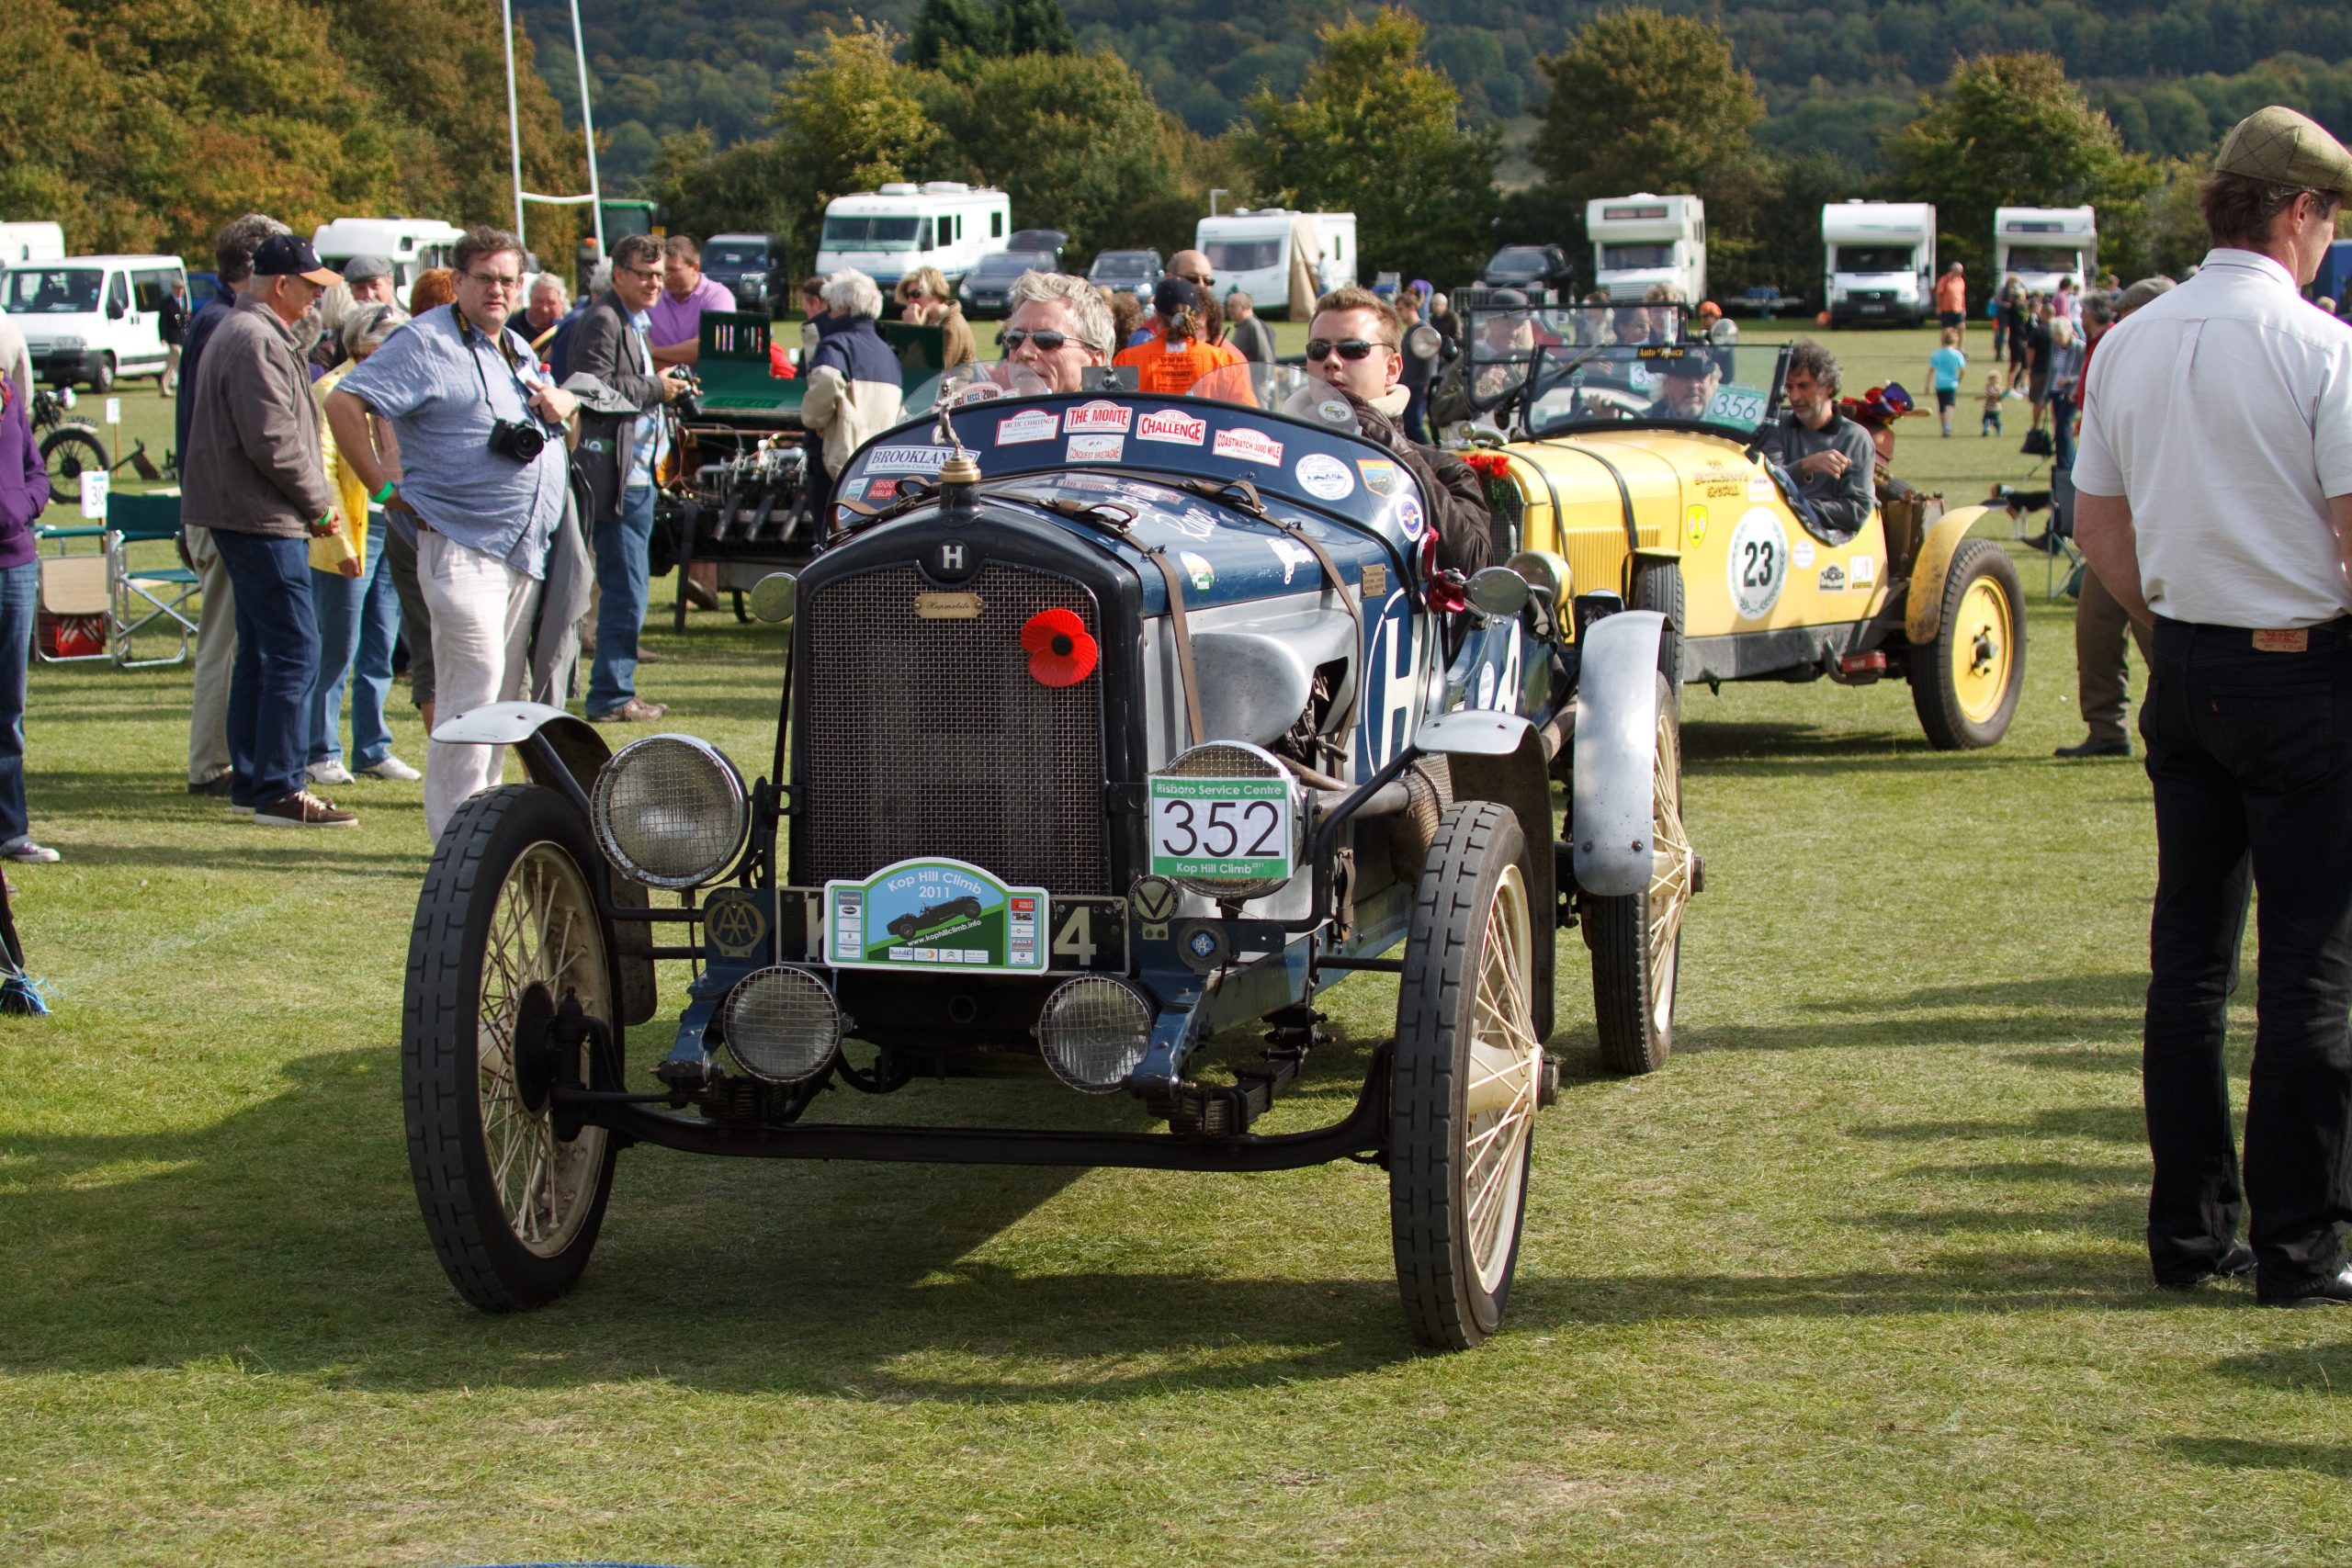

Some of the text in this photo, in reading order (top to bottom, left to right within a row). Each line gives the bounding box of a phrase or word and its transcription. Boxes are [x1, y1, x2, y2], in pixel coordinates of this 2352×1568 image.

[1069, 409, 1128, 427] THE MONTE
[1713, 393, 1758, 421] 356
[1023, 417, 1055, 426] CHALLENGE
[1141, 416, 1202, 441] CHALLENGE
[1216, 433, 1253, 449] COASTWATCH
[1268, 444, 1282, 459] MILE
[876, 480, 895, 489] 1000
[943, 545, 963, 570] H
[1744, 540, 1773, 588] 23
[1380, 613, 1423, 776] H
[1156, 784, 1283, 795] Risboro Service Centre
[1163, 799, 1280, 858] 352
[1176, 863, 1197, 874] Kop
[1200, 863, 1216, 874] Hill
[887, 871, 982, 895] Kop Hill Climb
[919, 886, 950, 899] 2011
[1136, 887, 1170, 919] V
[716, 905, 756, 946] AA
[907, 919, 982, 947] www.kophillclimb.info
[1053, 906, 1097, 966] 4
[1194, 936, 1211, 953] RAC
